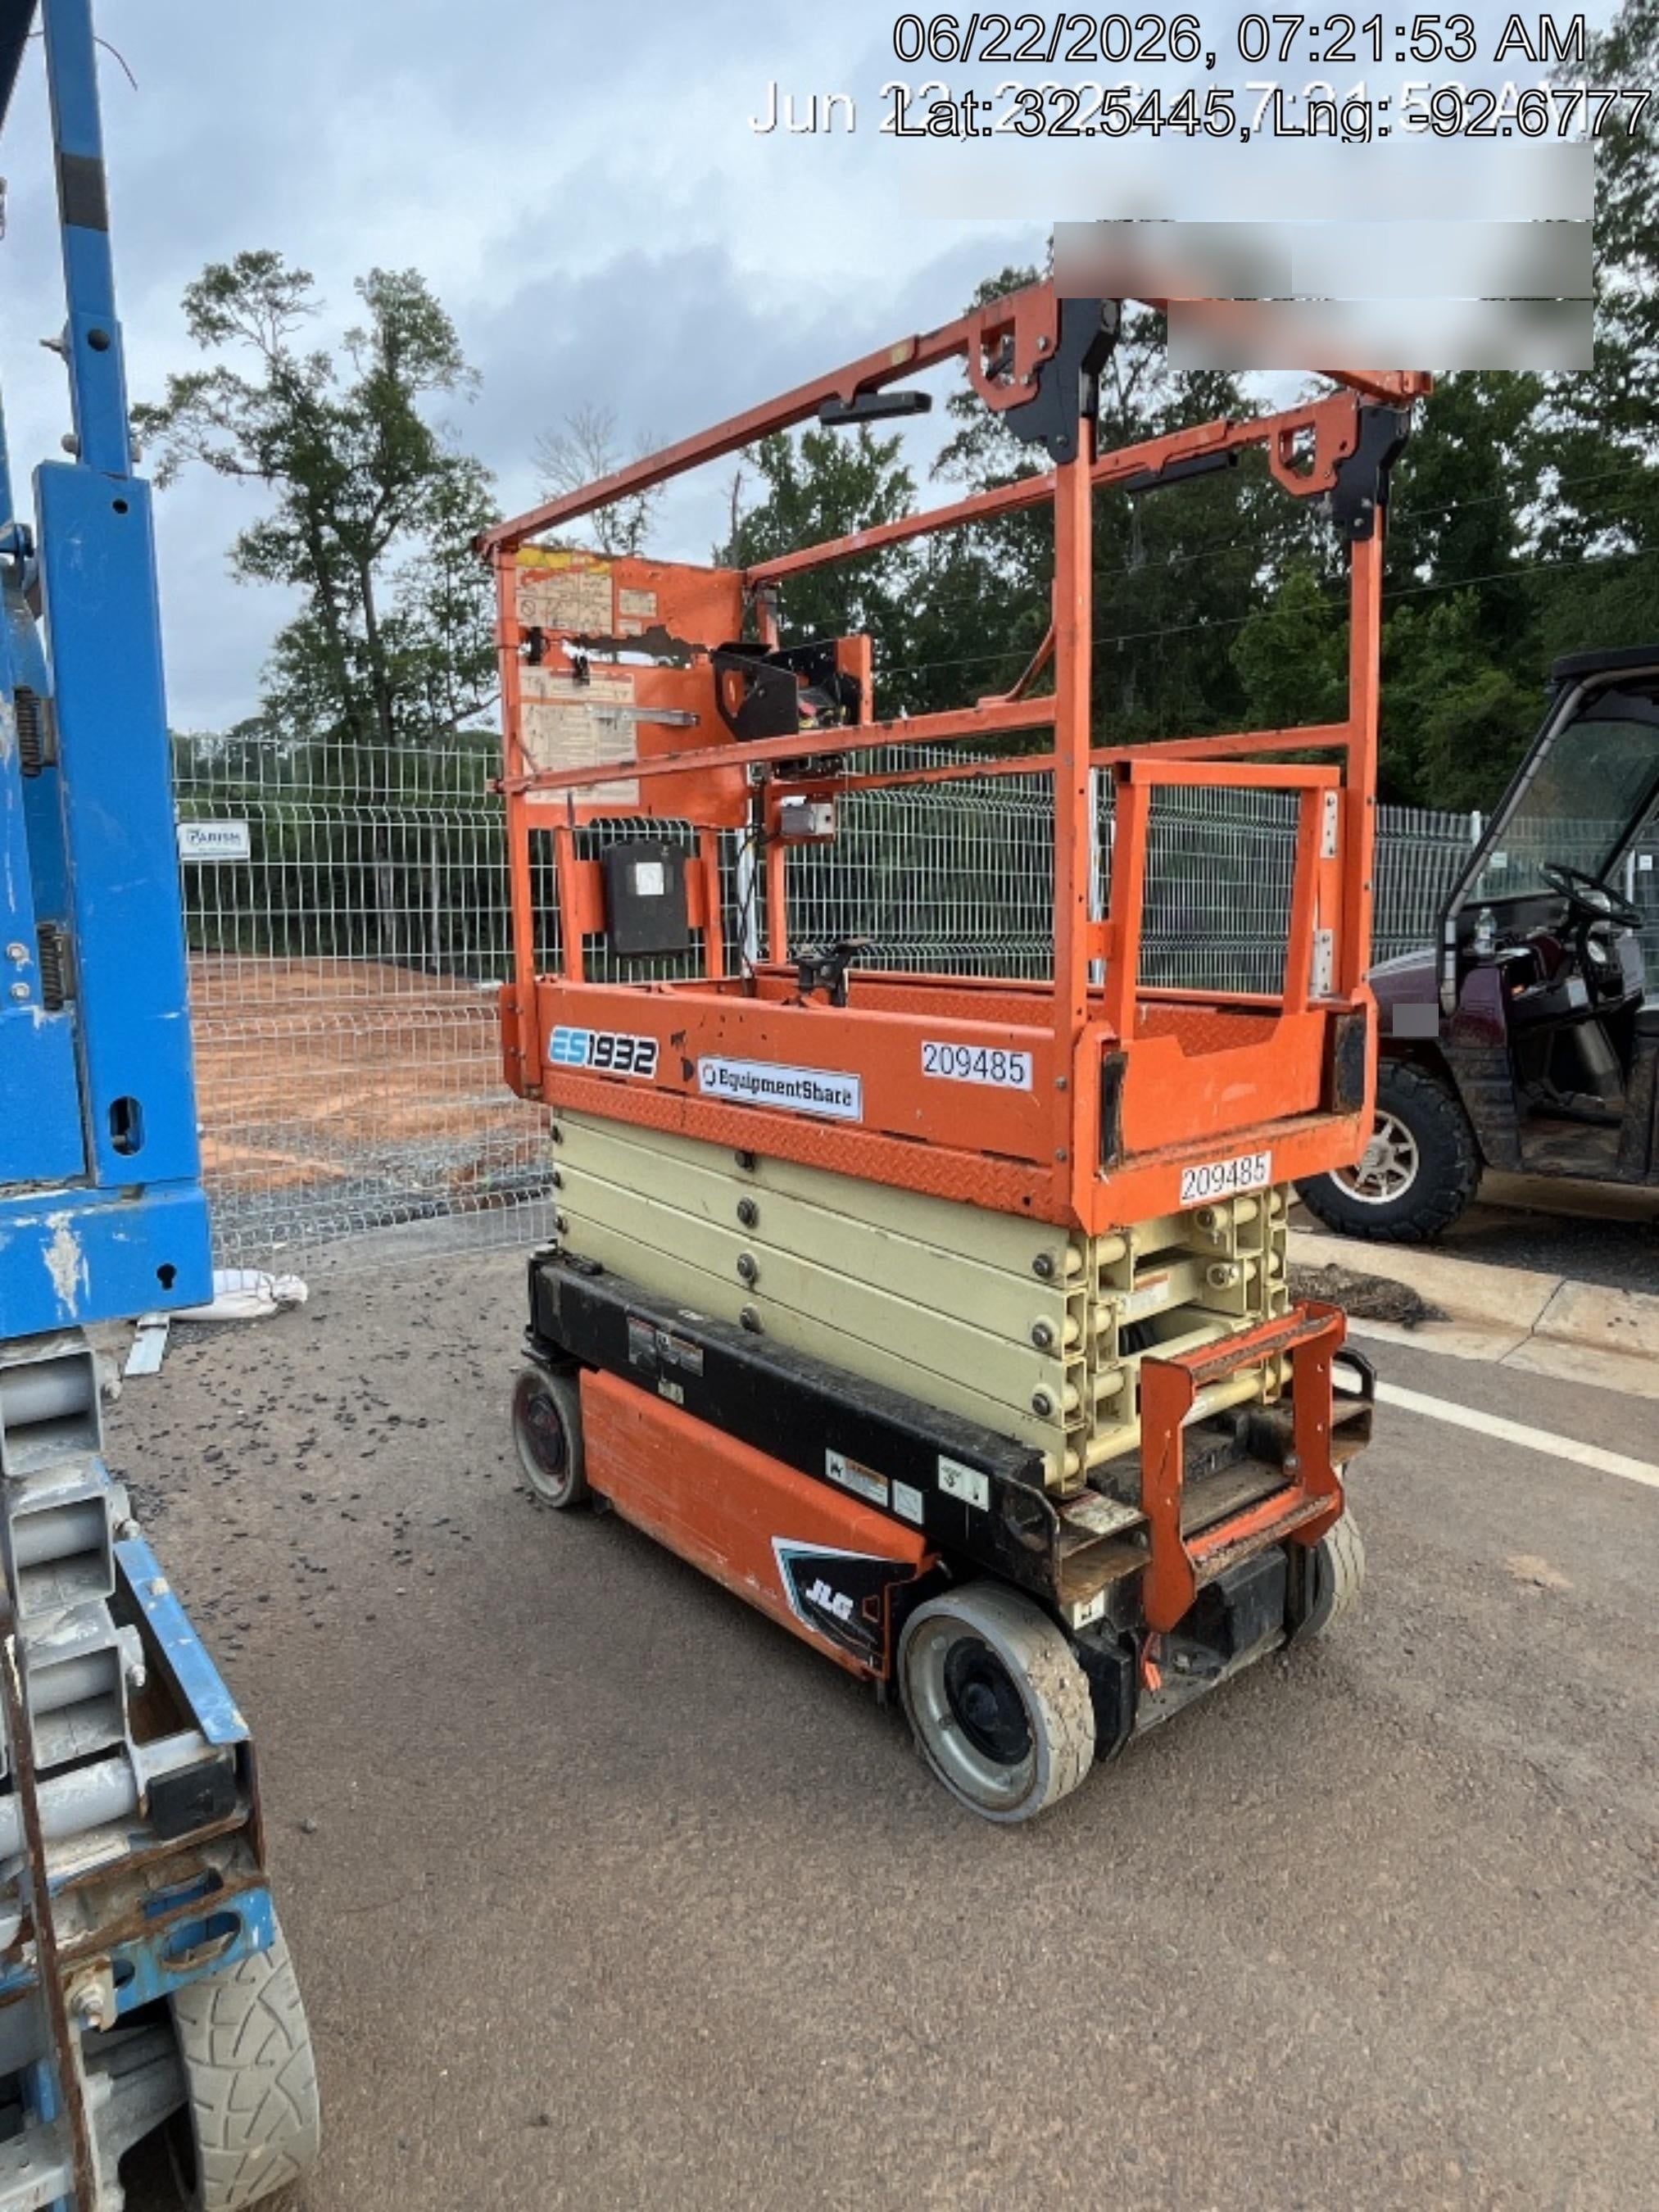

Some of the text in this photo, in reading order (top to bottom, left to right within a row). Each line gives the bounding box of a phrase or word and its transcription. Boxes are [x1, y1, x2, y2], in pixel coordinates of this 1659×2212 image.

[550, 1028, 656, 1075] ES1932
[923, 1043, 1024, 1083] 209485
[718, 1067, 853, 1107] EquipmentShare
[1181, 1154, 1267, 1200] 209485
[805, 1578, 854, 1621] JLG
